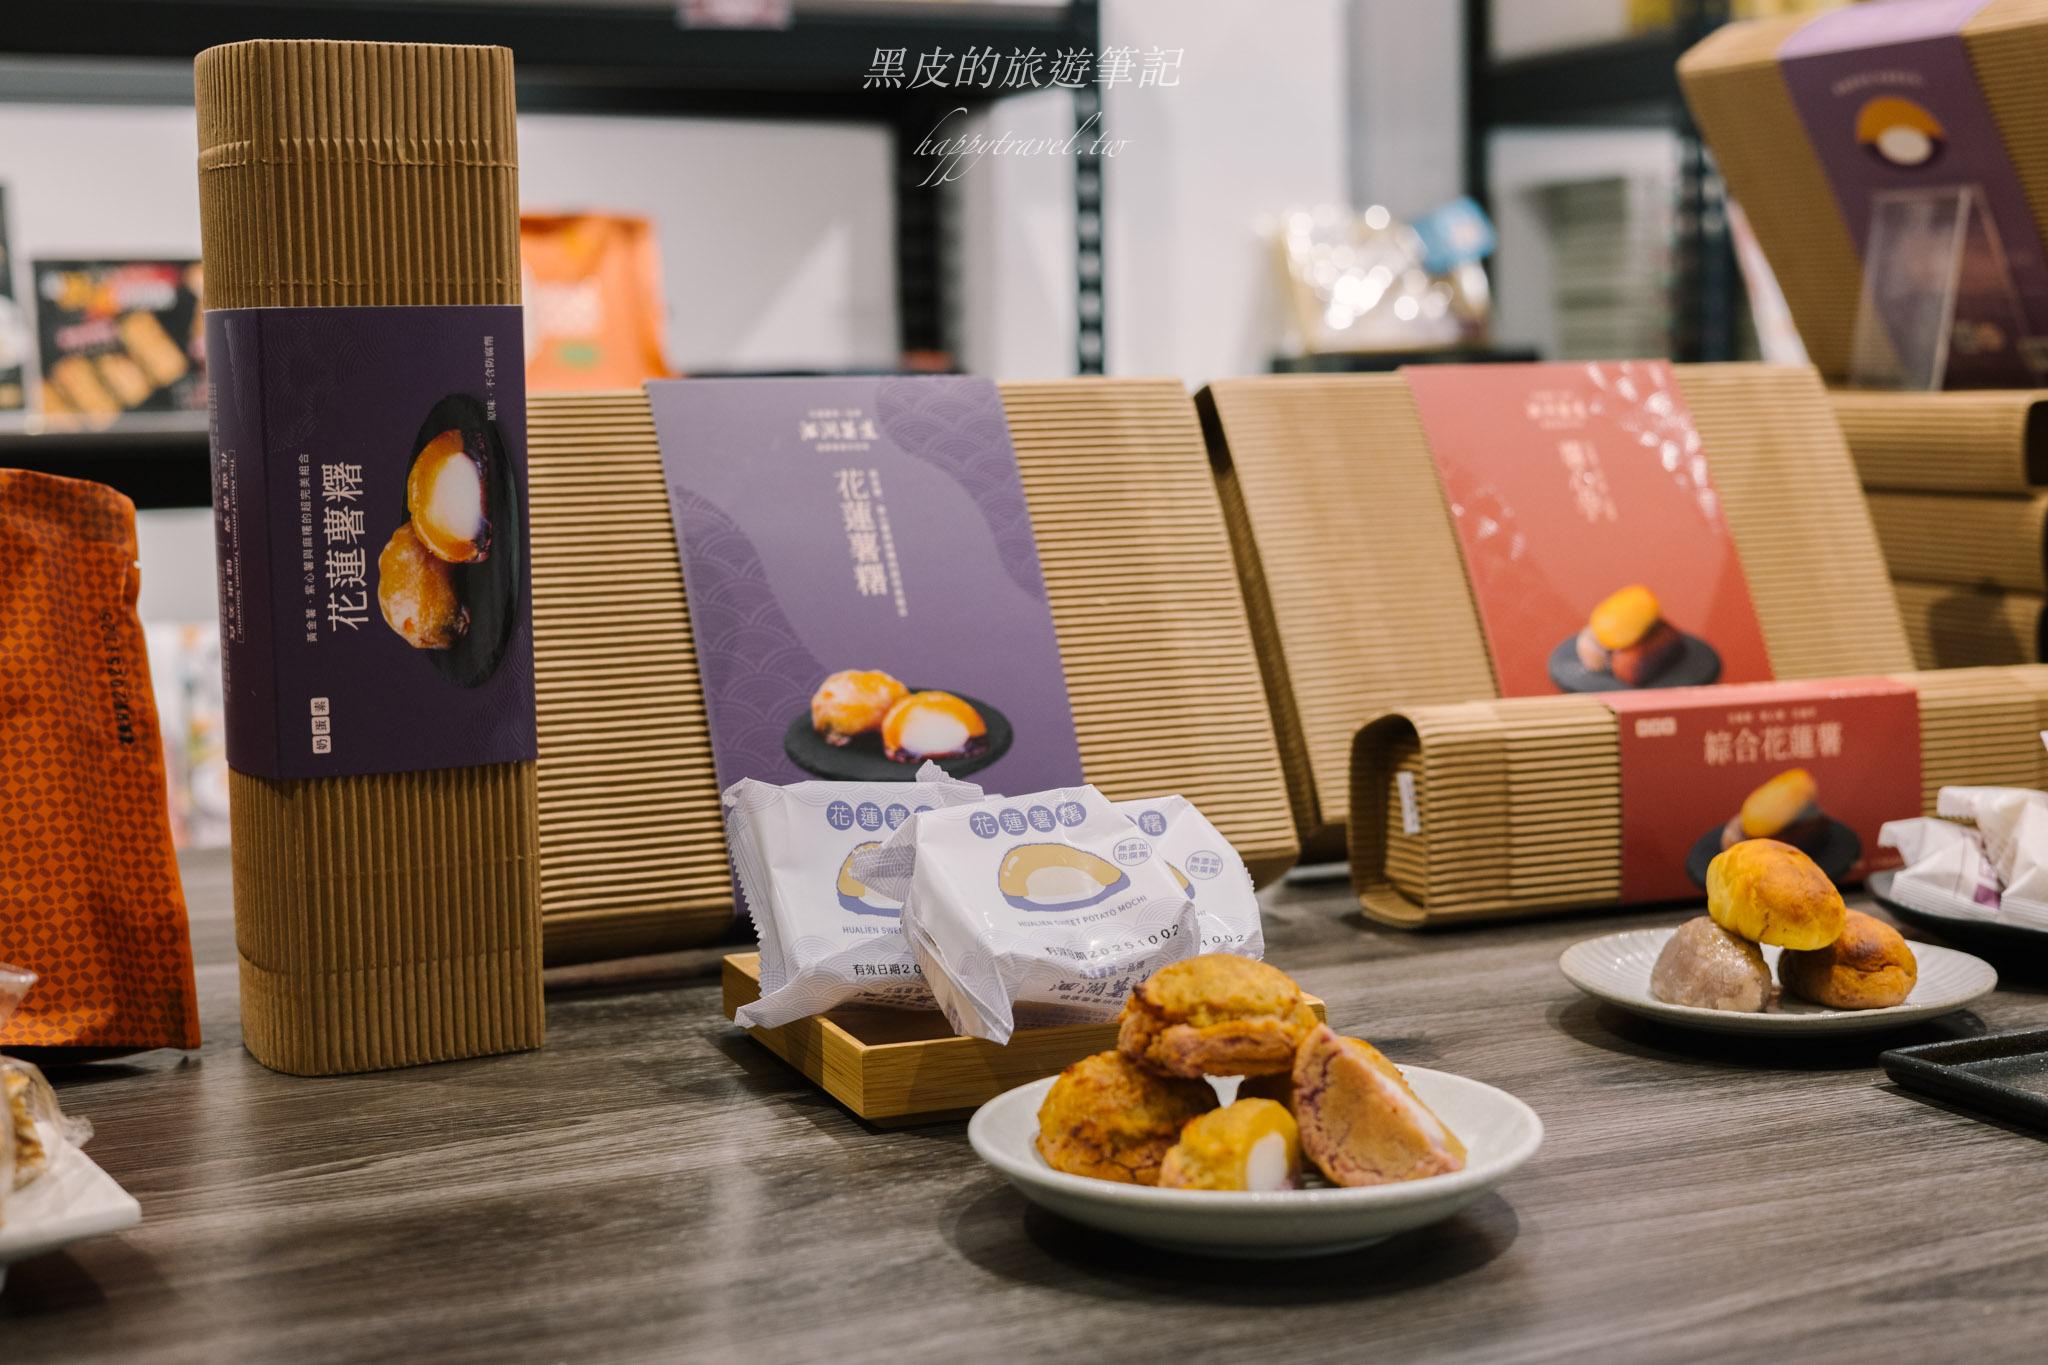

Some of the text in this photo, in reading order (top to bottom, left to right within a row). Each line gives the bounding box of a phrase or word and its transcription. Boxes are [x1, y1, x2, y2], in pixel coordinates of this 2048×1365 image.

[321, 460, 369, 633] 花蓮薯糬
[971, 803, 1084, 836] 花蓮薯糬
[1083, 908, 1117, 923] POTATO
[1117, 895, 1148, 914] MOCHI
